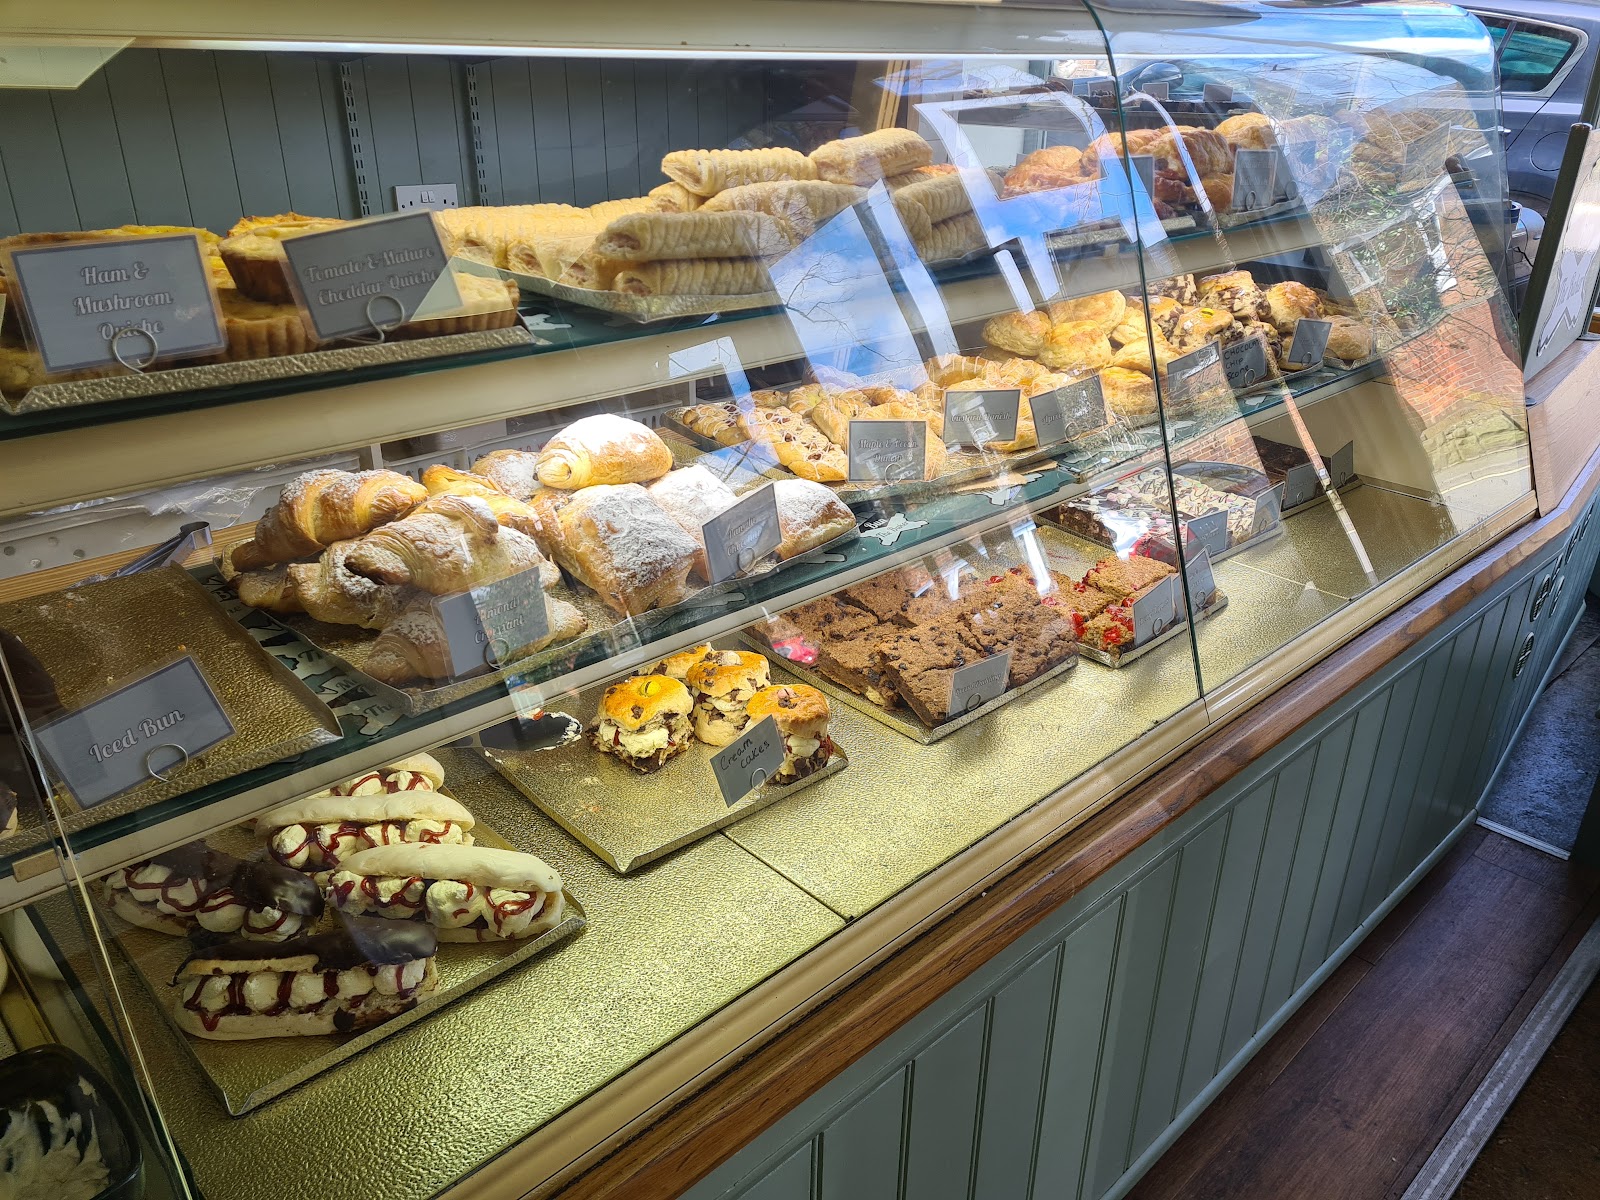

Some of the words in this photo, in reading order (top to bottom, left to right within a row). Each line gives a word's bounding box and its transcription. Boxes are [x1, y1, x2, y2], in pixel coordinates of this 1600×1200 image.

[80, 265, 131, 286] Ham
[133, 261, 150, 281] &
[304, 261, 364, 283] Tomato
[366, 253, 380, 271] &
[379, 246, 436, 267] Mature
[73, 290, 175, 316] Mushroom
[318, 279, 384, 306] Cheddar
[474, 613, 525, 645] Crissant
[89, 728, 139, 763] Iced
[138, 709, 186, 739] Bun
[719, 738, 754, 771] Cream
